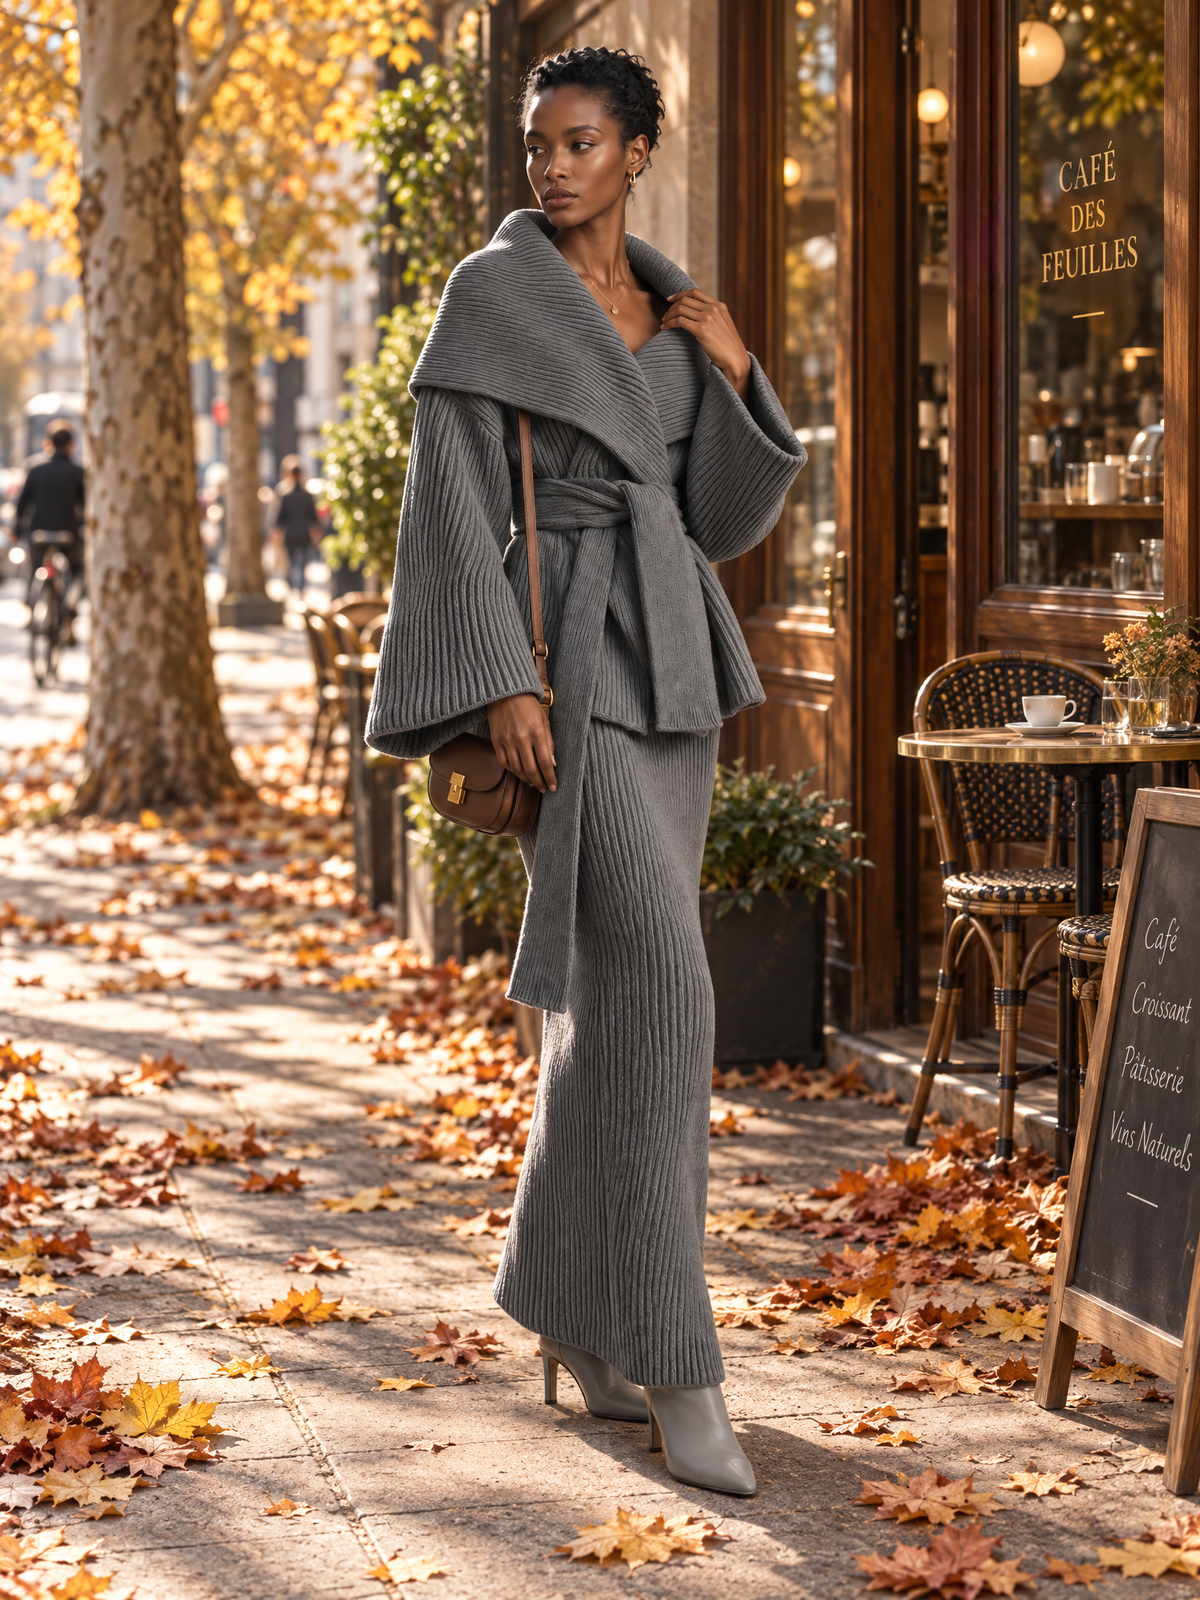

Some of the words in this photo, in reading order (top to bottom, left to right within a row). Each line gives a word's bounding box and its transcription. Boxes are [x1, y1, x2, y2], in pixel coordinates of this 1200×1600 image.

[1059, 140, 1117, 192] CAFÉ
[1070, 198, 1106, 233] DES
[1042, 235, 1138, 283] FEUILLES
[1144, 917, 1180, 965] Café
[1132, 981, 1192, 1024] Croissant
[1121, 1045, 1184, 1094] Pâtisserie
[1110, 1110, 1136, 1148] Vins
[1137, 1120, 1193, 1172] Naturels
